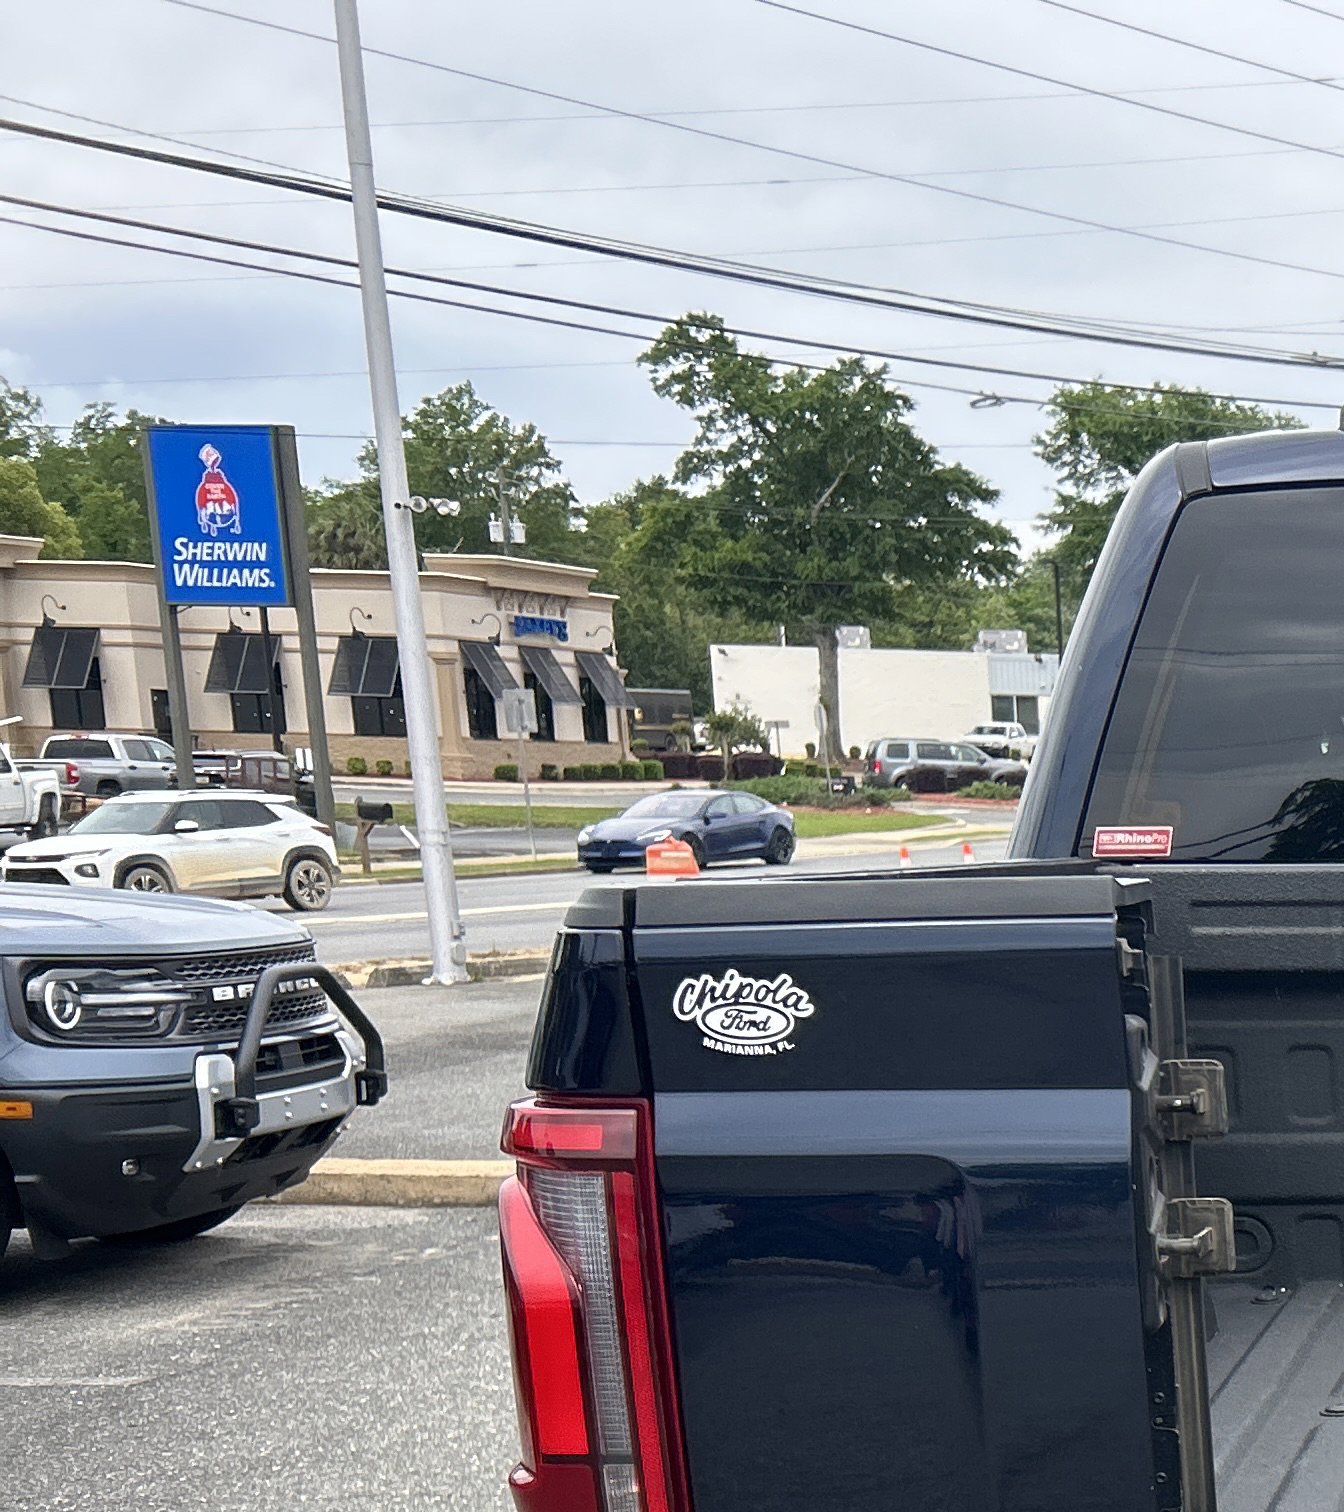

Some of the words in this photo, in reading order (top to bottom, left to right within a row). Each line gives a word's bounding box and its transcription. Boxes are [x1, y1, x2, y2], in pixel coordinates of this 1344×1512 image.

[173, 537, 267, 561] SHERWIN
[677, 972, 811, 1016] Chipola
[719, 1008, 772, 1032] Ford
[702, 1037, 777, 1056] MARIANNA,
